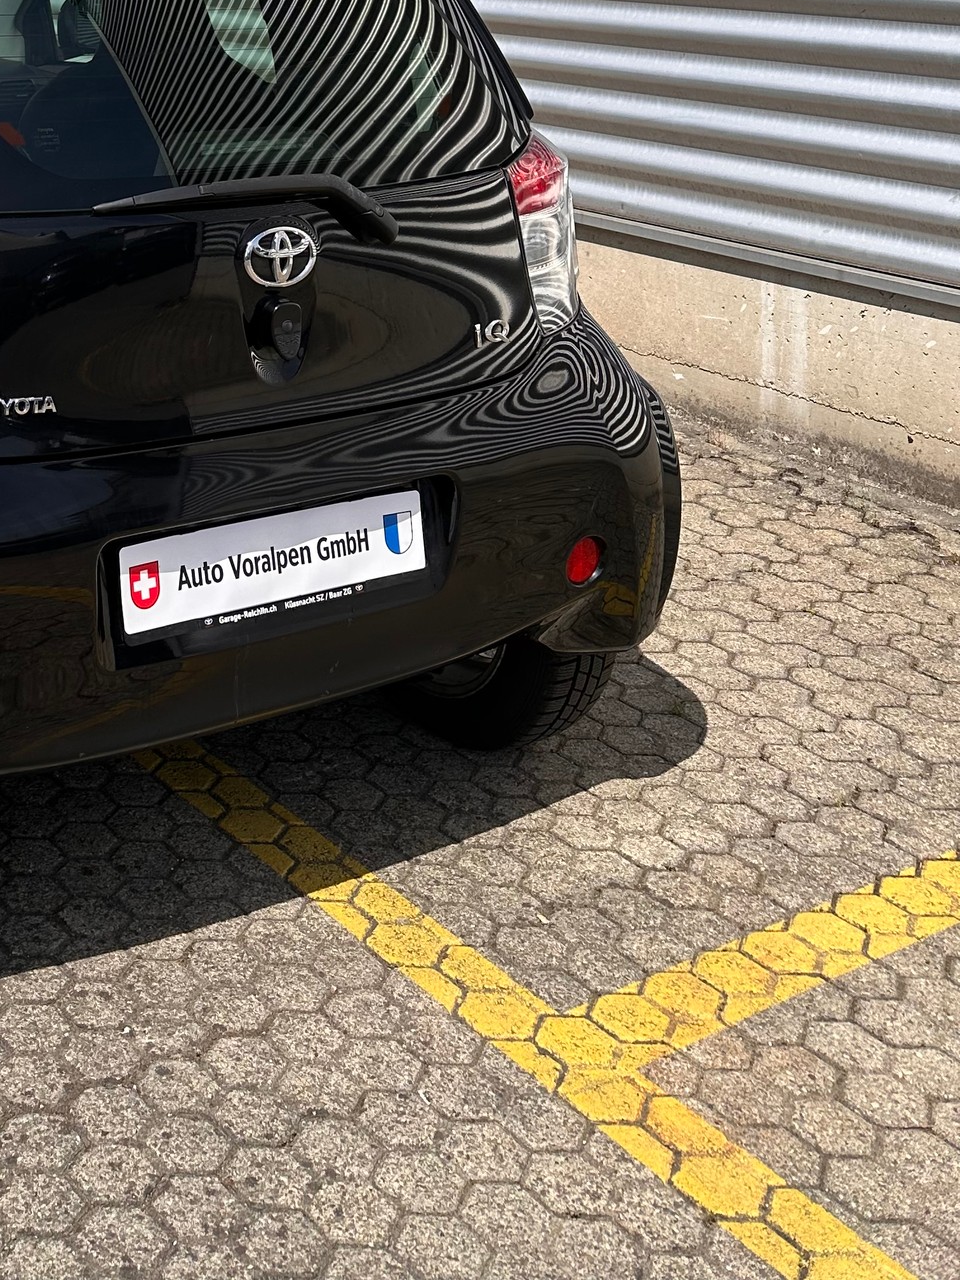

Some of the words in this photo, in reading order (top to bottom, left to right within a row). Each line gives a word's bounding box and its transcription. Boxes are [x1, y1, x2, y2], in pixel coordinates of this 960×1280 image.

[177, 561, 224, 591] Auto
[228, 545, 312, 580] Voralpen
[317, 528, 370, 560] GmbH
[316, 593, 325, 602] SZ
